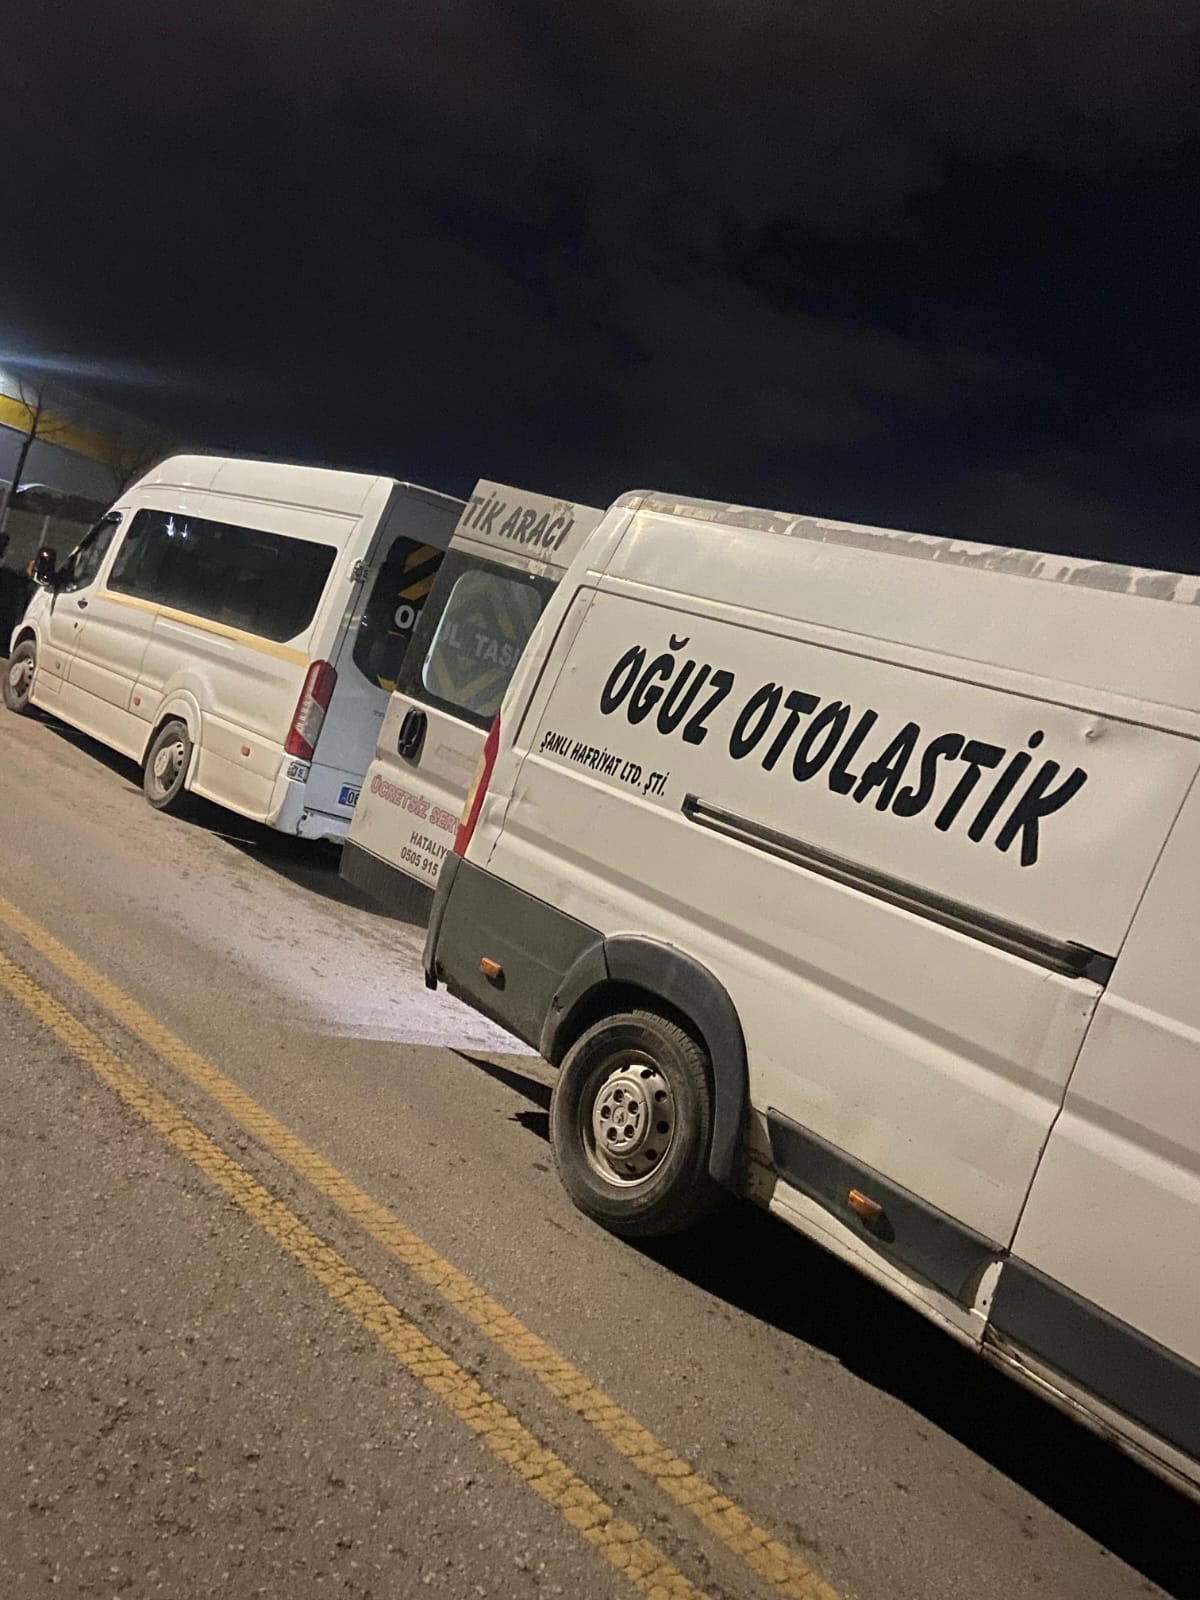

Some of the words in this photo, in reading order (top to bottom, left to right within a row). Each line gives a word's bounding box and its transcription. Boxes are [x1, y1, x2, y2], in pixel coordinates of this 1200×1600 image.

[462, 491, 506, 535] TİK
[499, 506, 575, 551] ARACI
[540, 731, 573, 757] ŞANLI
[570, 742, 623, 776] HAFRİYAT
[619, 761, 642, 787] LTD.
[642, 772, 671, 796] ŞTİ.
[600, 633, 735, 746] OĞUZ
[729, 681, 1088, 868] OTOLASTİK
[400, 846, 422, 868] 0505
[421, 858, 439, 877] 915
